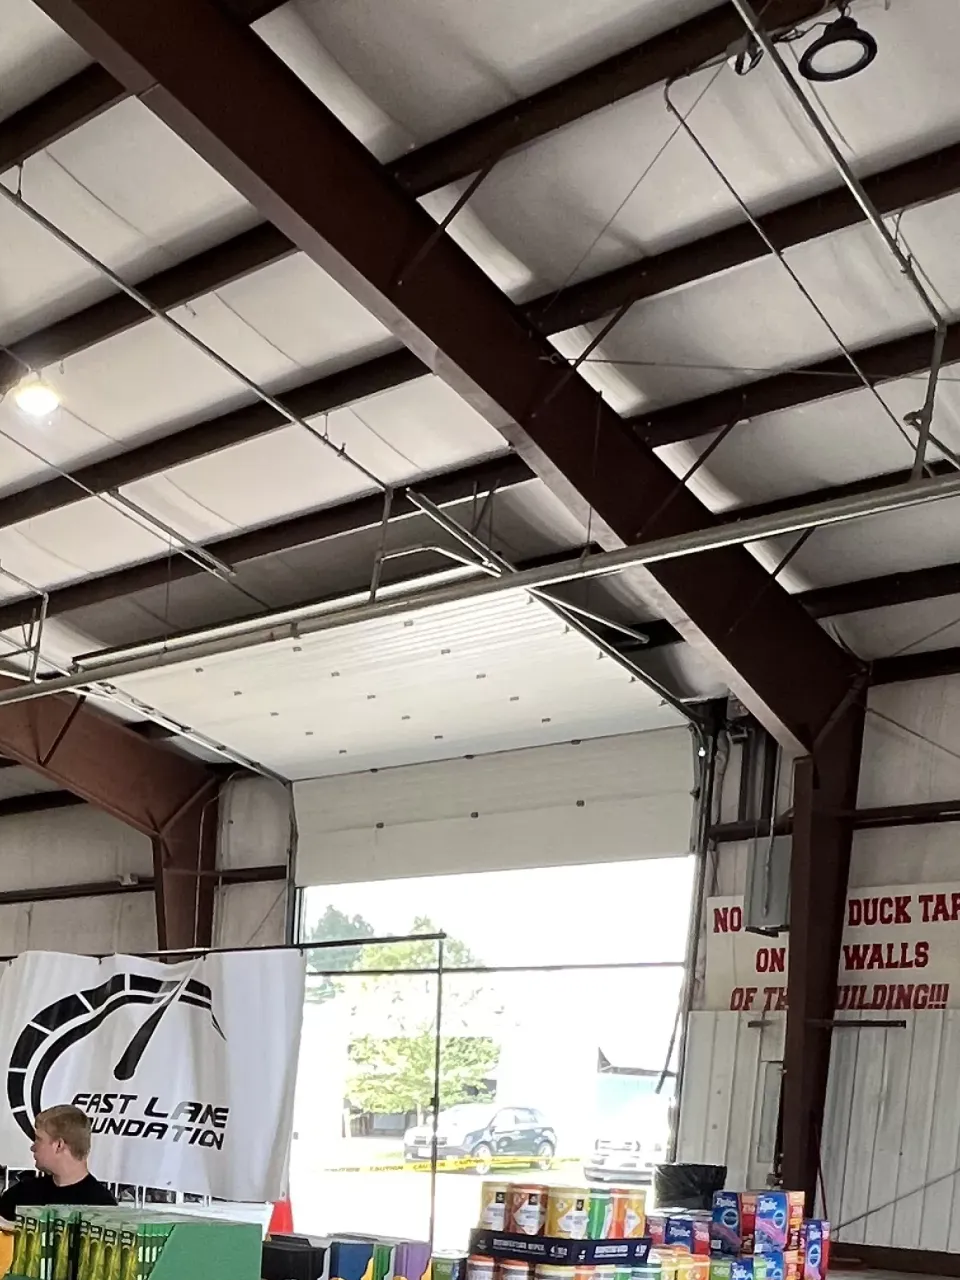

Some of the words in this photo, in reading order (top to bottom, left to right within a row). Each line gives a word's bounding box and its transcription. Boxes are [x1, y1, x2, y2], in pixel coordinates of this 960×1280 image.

[713, 906, 742, 933] NO
[848, 895, 912, 926] DUCK
[755, 947, 786, 973] ON
[842, 941, 930, 971] WALLS
[730, 987, 758, 1011] OF
[837, 983, 950, 1010] UILDING!!!
[71, 1093, 138, 1115] FAST
[144, 1096, 230, 1129] LANE
